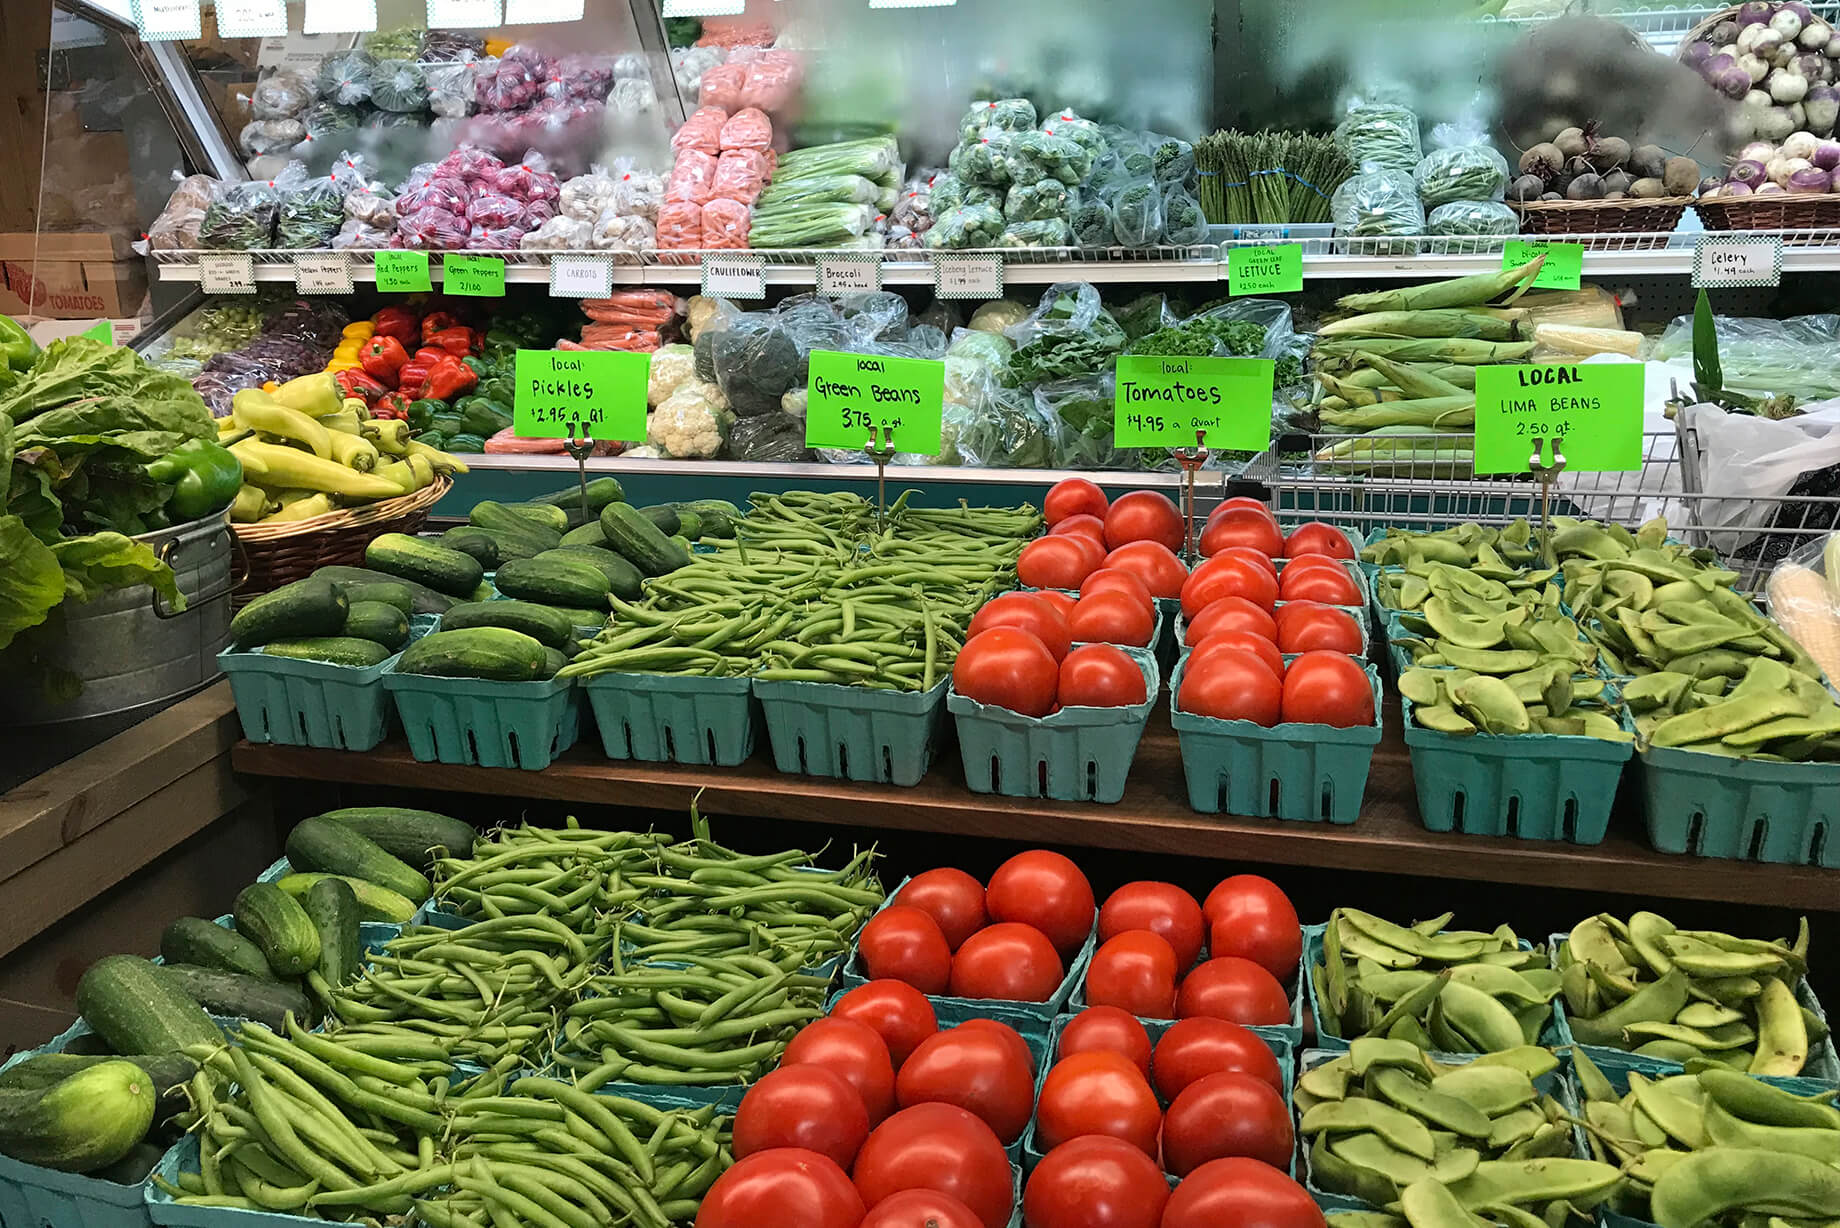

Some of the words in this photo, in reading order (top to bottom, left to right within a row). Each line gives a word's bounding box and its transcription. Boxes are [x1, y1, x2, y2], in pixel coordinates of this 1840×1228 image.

[1711, 251, 1748, 266] Celery
[391, 263, 418, 274] Peppers
[448, 265, 468, 276] Green
[472, 267, 499, 277] Peppers
[566, 268, 598, 279] CARROTS
[709, 266, 761, 278] CAULIFLOWER
[825, 267, 861, 279] Broccoli
[942, 264, 966, 276] Iceberg
[1238, 264, 1282, 278] LETTUCE
[48, 295, 105, 310] TOMATOES
[551, 356, 582, 371] local
[856, 359, 885, 373] local
[1161, 360, 1189, 374] local
[1518, 366, 1583, 387] LOCAL
[531, 379, 594, 400] Pickles
[815, 375, 862, 400] Green
[870, 384, 921, 405] Beans
[1121, 381, 1222, 405] Tomatoes
[1500, 398, 1537, 414] LIMA
[1549, 396, 1601, 413] BEANS
[571, 410, 580, 422] a
[841, 407, 872, 428] 3.75
[881, 418, 888, 426] a
[1127, 413, 1165, 432] $4.95
[1190, 416, 1222, 428] Quart
[1515, 421, 1549, 436] 2.50
